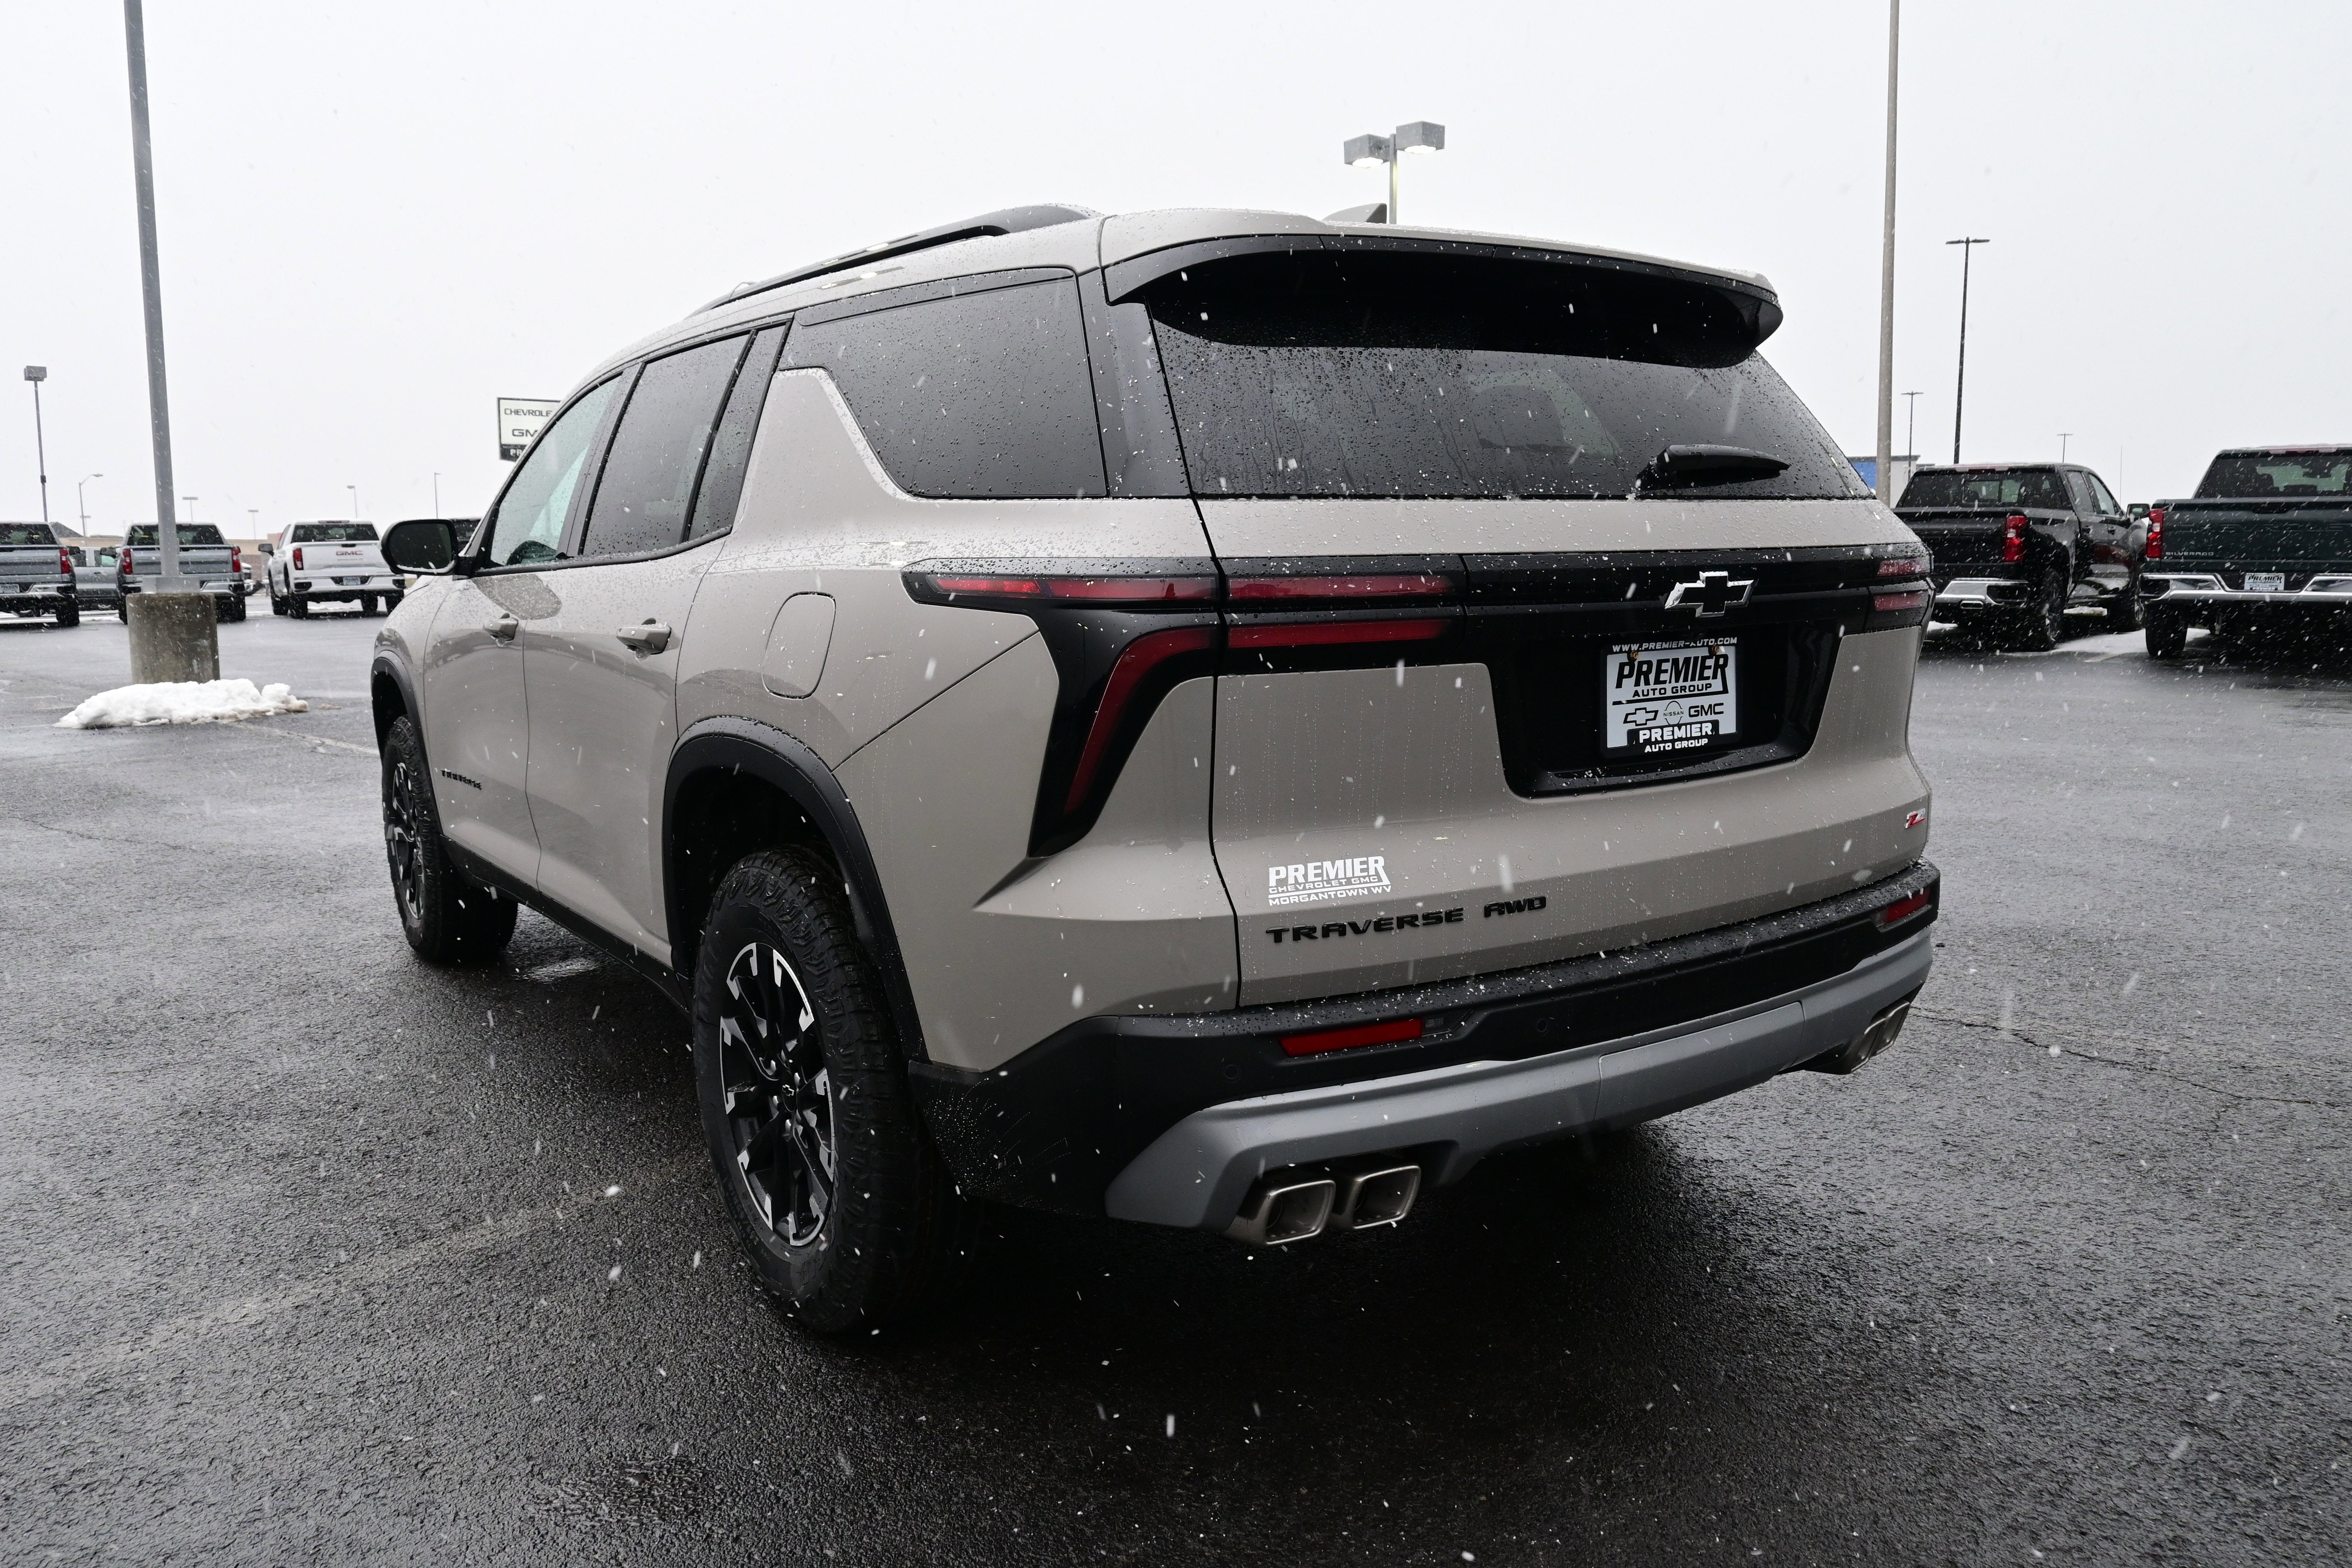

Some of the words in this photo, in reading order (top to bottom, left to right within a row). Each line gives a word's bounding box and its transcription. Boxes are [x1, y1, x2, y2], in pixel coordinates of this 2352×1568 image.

[1612, 637, 1737, 652] WWW.PREMIER-AUTO.COM
[1615, 654, 1729, 689] PREMIER
[1633, 687, 1666, 698] AUTO
[1671, 683, 1712, 694] GROUP
[1688, 702, 1724, 718] GMC
[1639, 723, 1712, 743] PREMIER
[1644, 743, 1672, 753] AUTO
[1675, 738, 1708, 749] GROUP
[1269, 856, 1391, 887] PREMIER
[1269, 879, 1347, 893] CHEVROLET
[1269, 889, 1368, 906] MORGANTOWN
[1371, 885, 1391, 894] WV
[1266, 907, 1464, 943] TRAVERSE
[1484, 896, 1546, 917] AWD
